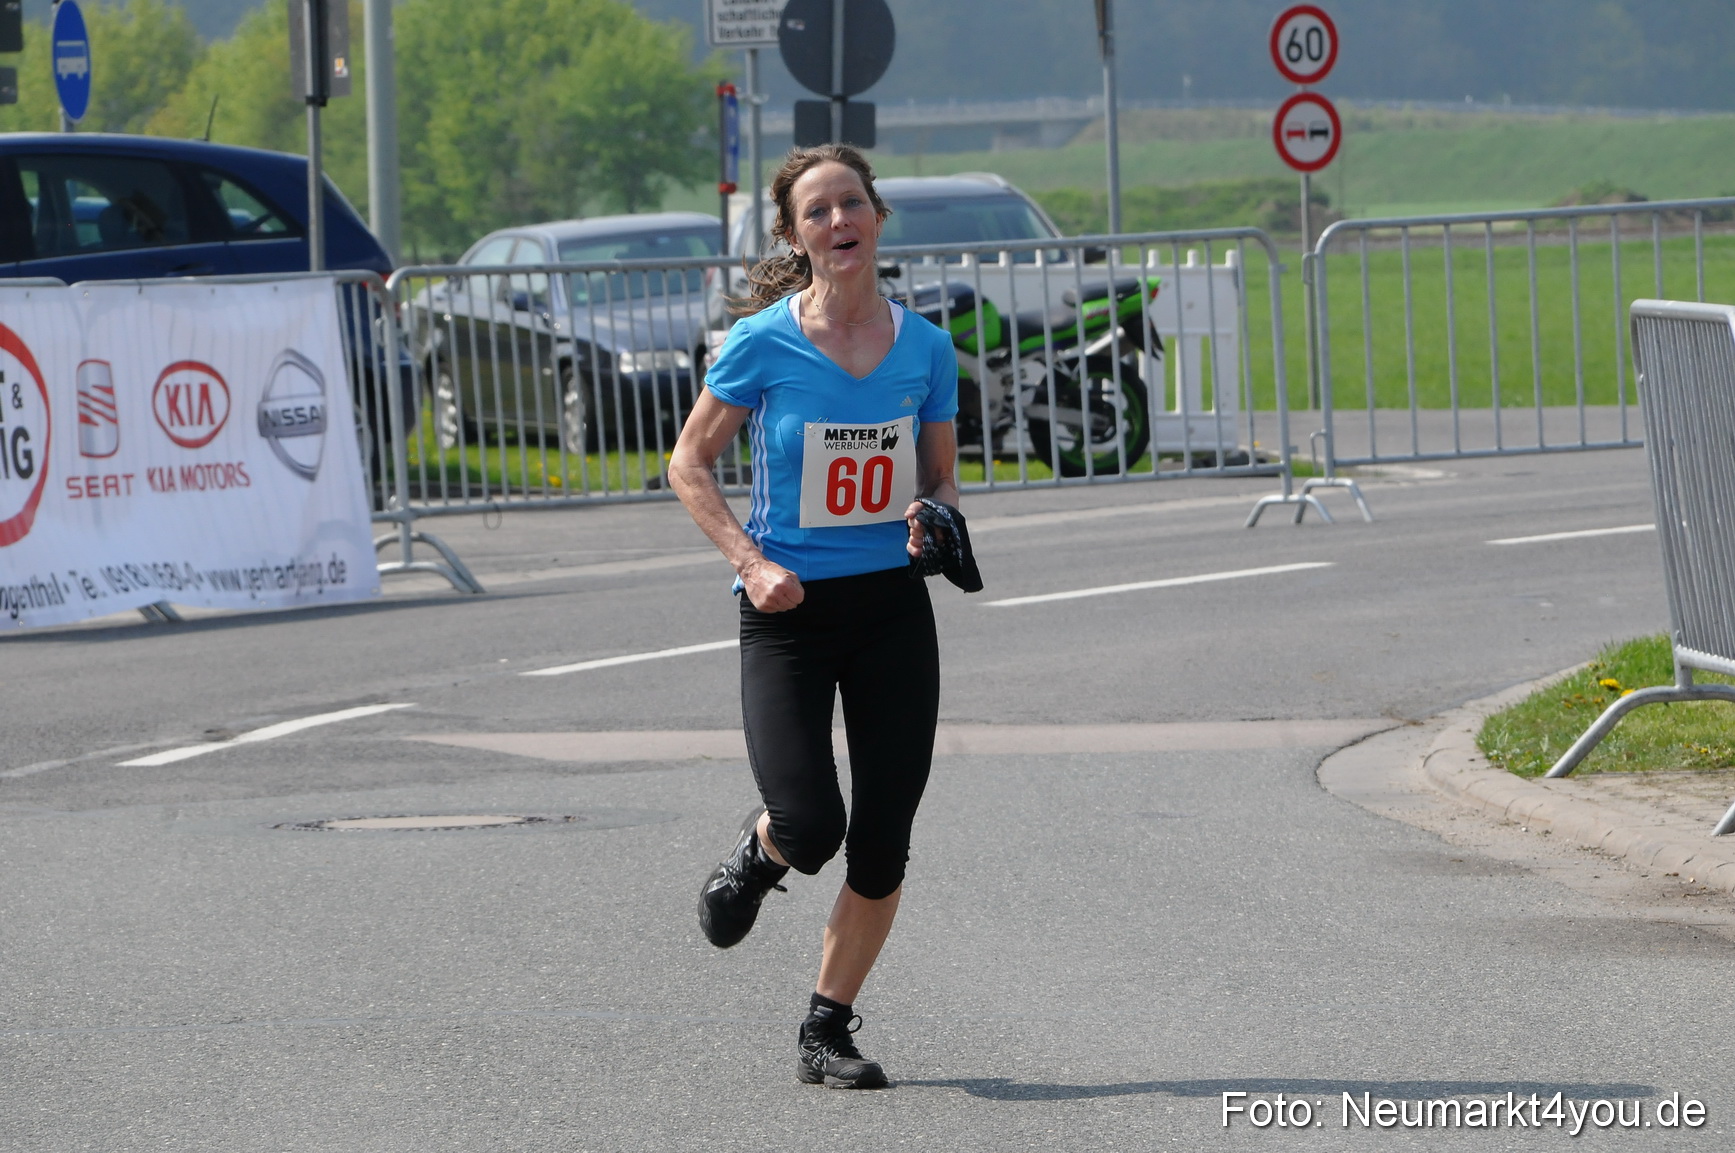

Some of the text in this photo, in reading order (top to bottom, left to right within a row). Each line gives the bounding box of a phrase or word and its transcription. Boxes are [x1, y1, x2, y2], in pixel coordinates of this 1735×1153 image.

[717, 24, 763, 39] Verkehr
[1286, 26, 1323, 63] 60
[165, 383, 215, 427] KIA
[824, 428, 878, 441] MEYER
[824, 441, 878, 451] WERBUNG
[66, 473, 135, 499] SEAT
[147, 462, 251, 492] KIA MOTORS
[826, 455, 894, 516] 60
